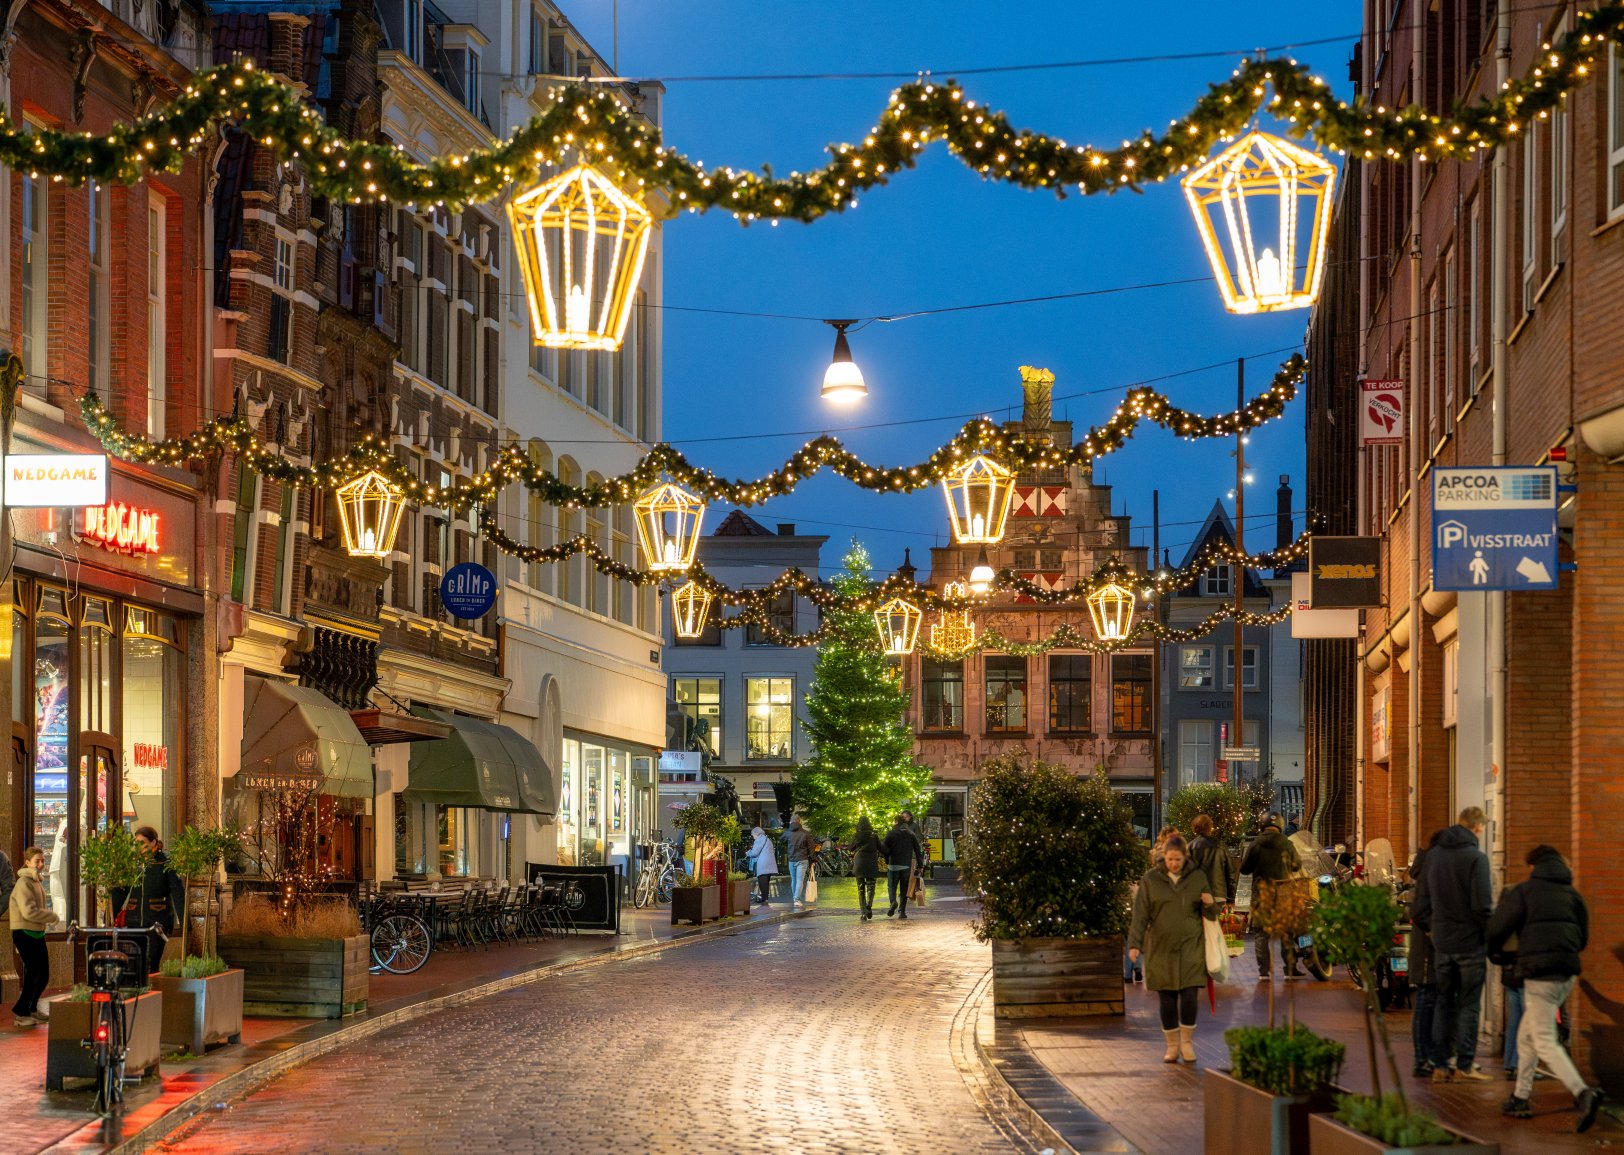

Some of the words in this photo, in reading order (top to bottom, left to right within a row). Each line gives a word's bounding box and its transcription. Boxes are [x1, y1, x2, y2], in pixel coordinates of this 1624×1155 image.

[1378, 381, 1404, 389] KOOP
[1368, 398, 1402, 419] VERKOCHT
[13, 467, 98, 481] NEDGAME
[1438, 475, 1499, 489] APCOA
[1437, 489, 1501, 502] PARKING
[1469, 533, 1552, 548] VISSTRAAT
[134, 743, 168, 770] NEDGAME
